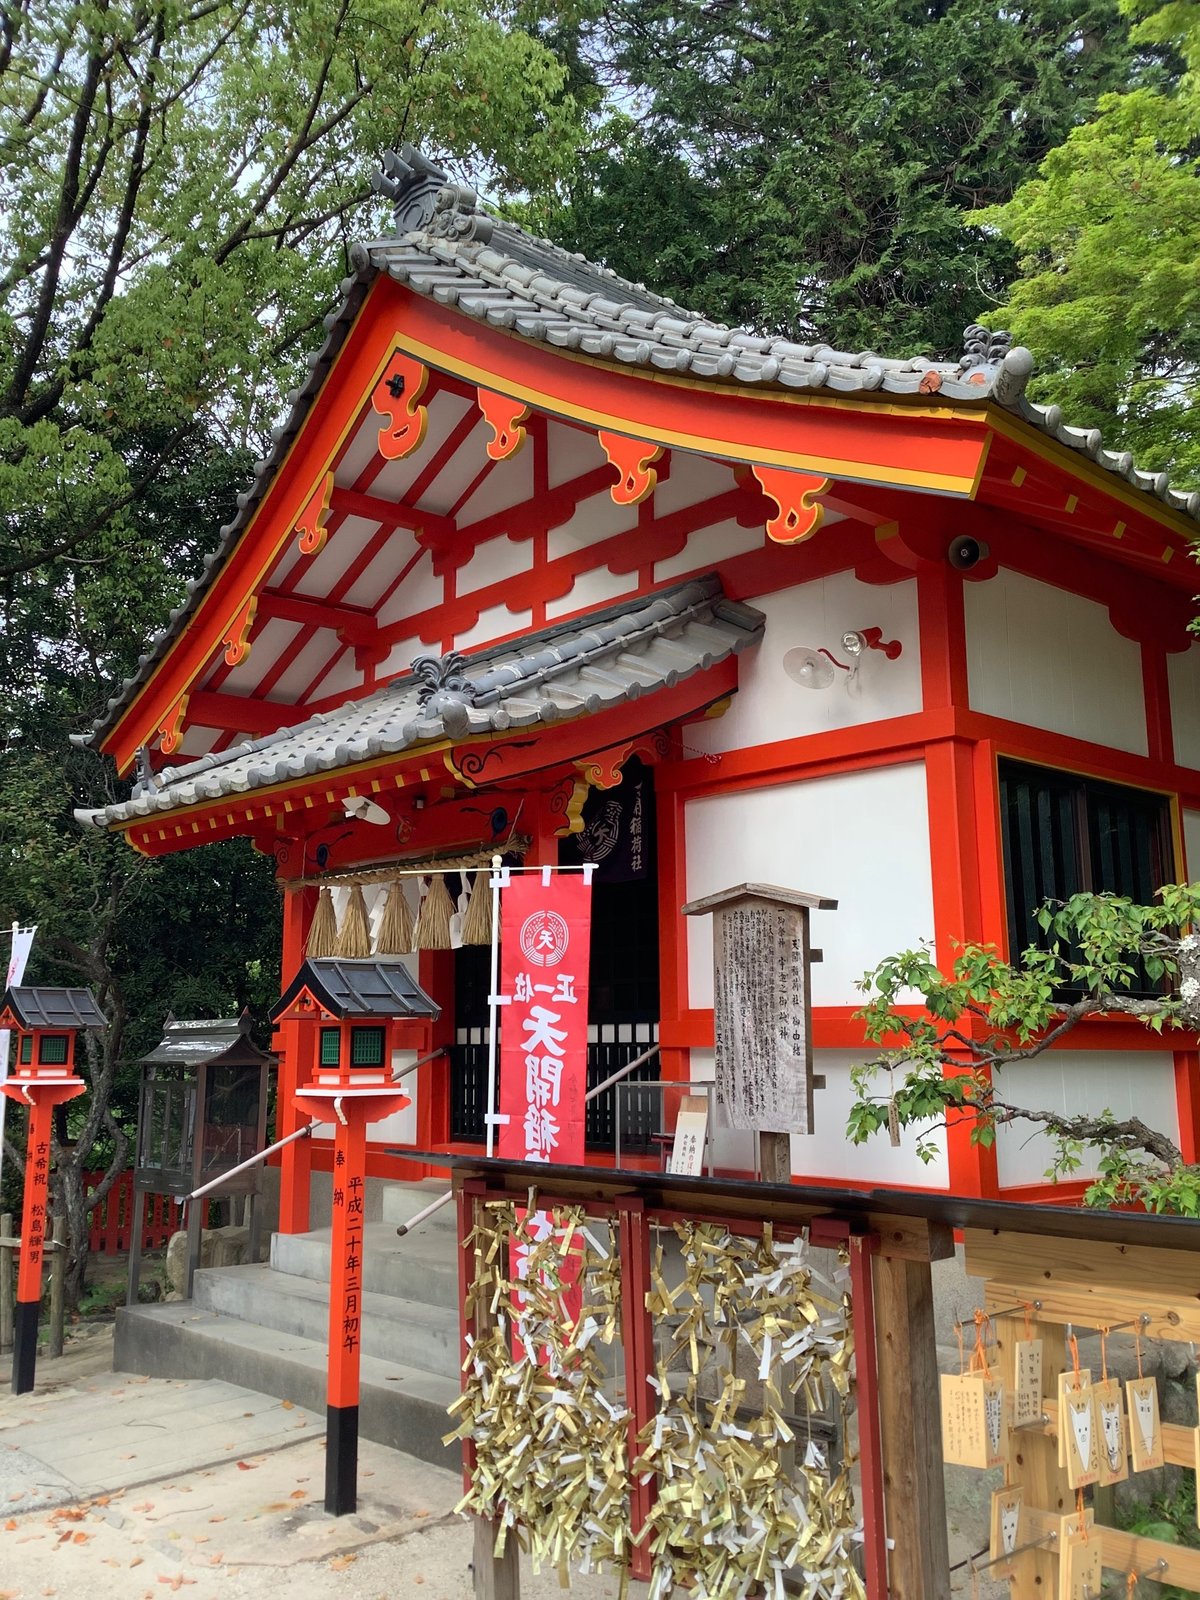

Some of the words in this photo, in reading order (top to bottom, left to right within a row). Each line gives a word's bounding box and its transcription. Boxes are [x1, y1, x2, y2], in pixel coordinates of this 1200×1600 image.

[33, 1142, 48, 1185] 古希祝
[29, 1204, 44, 1264] 松島輝男
[342, 1176, 364, 1354] 平成二十年三月初午
